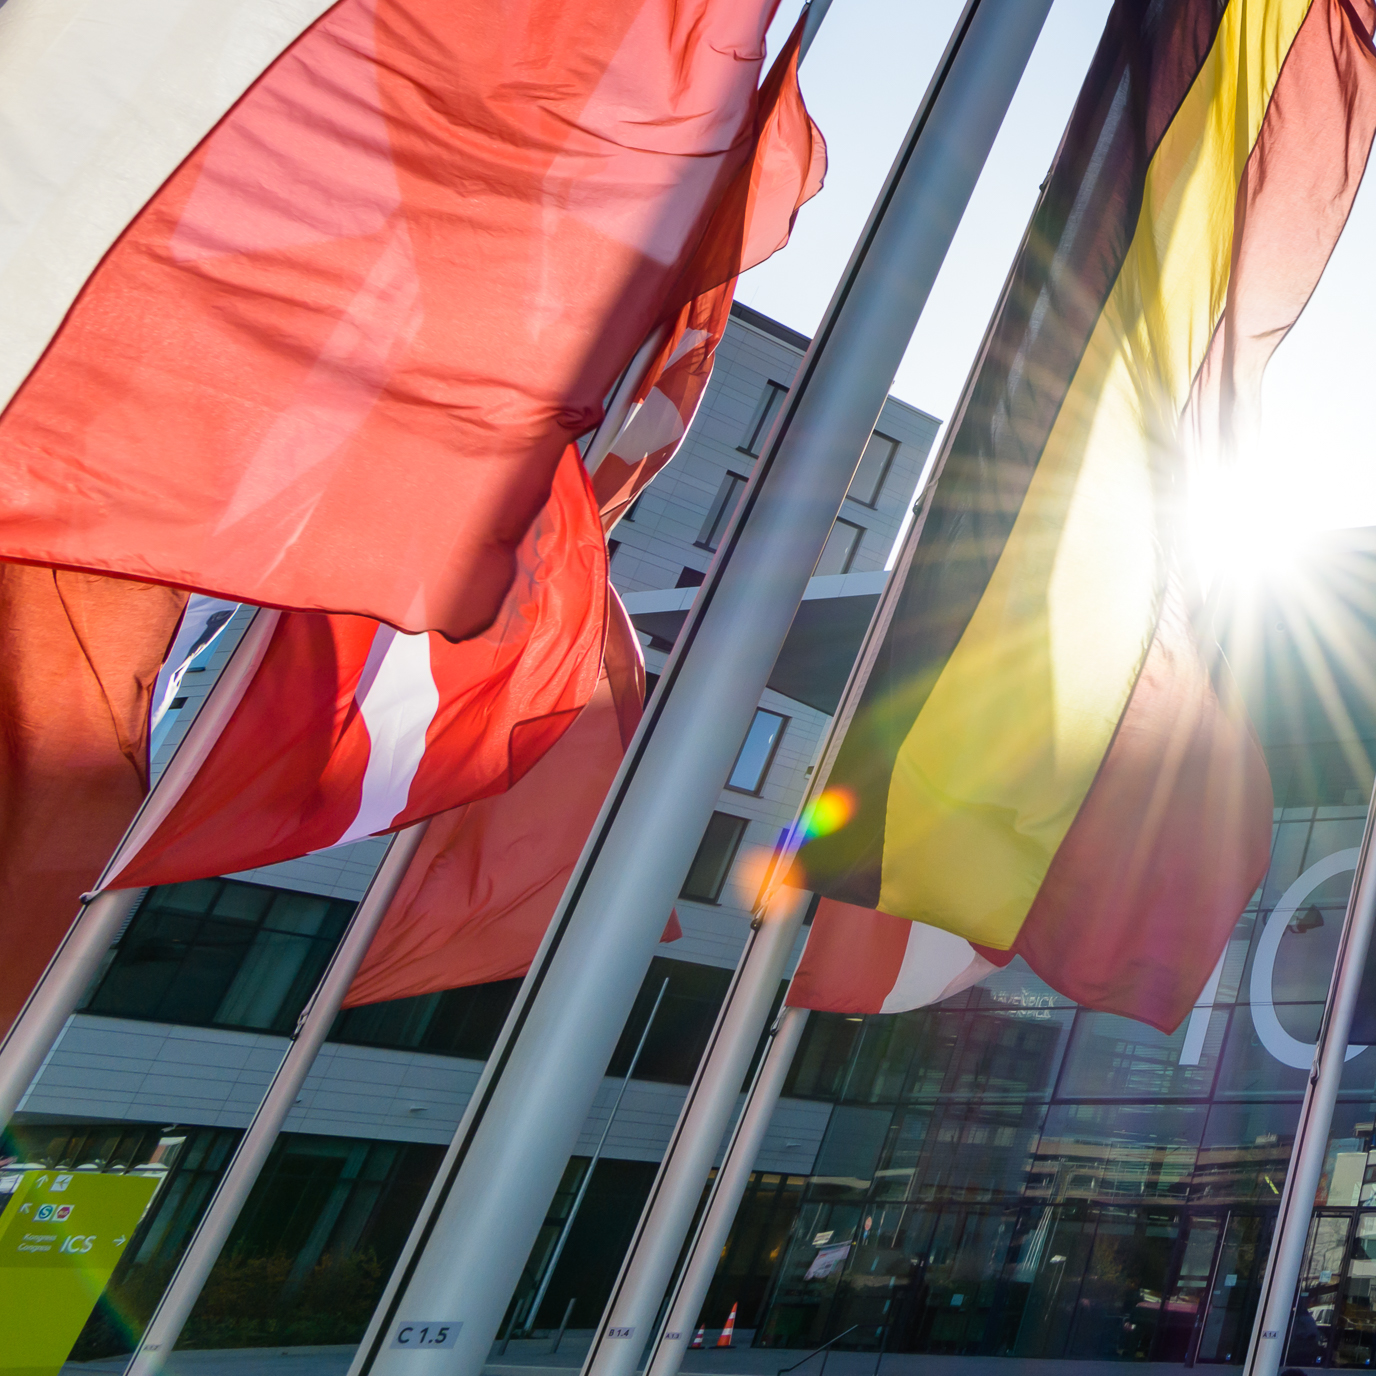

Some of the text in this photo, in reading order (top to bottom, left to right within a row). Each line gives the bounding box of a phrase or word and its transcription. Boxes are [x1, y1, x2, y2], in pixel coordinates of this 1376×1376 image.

[59, 1234, 97, 1254] ICS
[397, 1326, 451, 1344] C 1.5
[616, 1329, 630, 1337] 1.4
